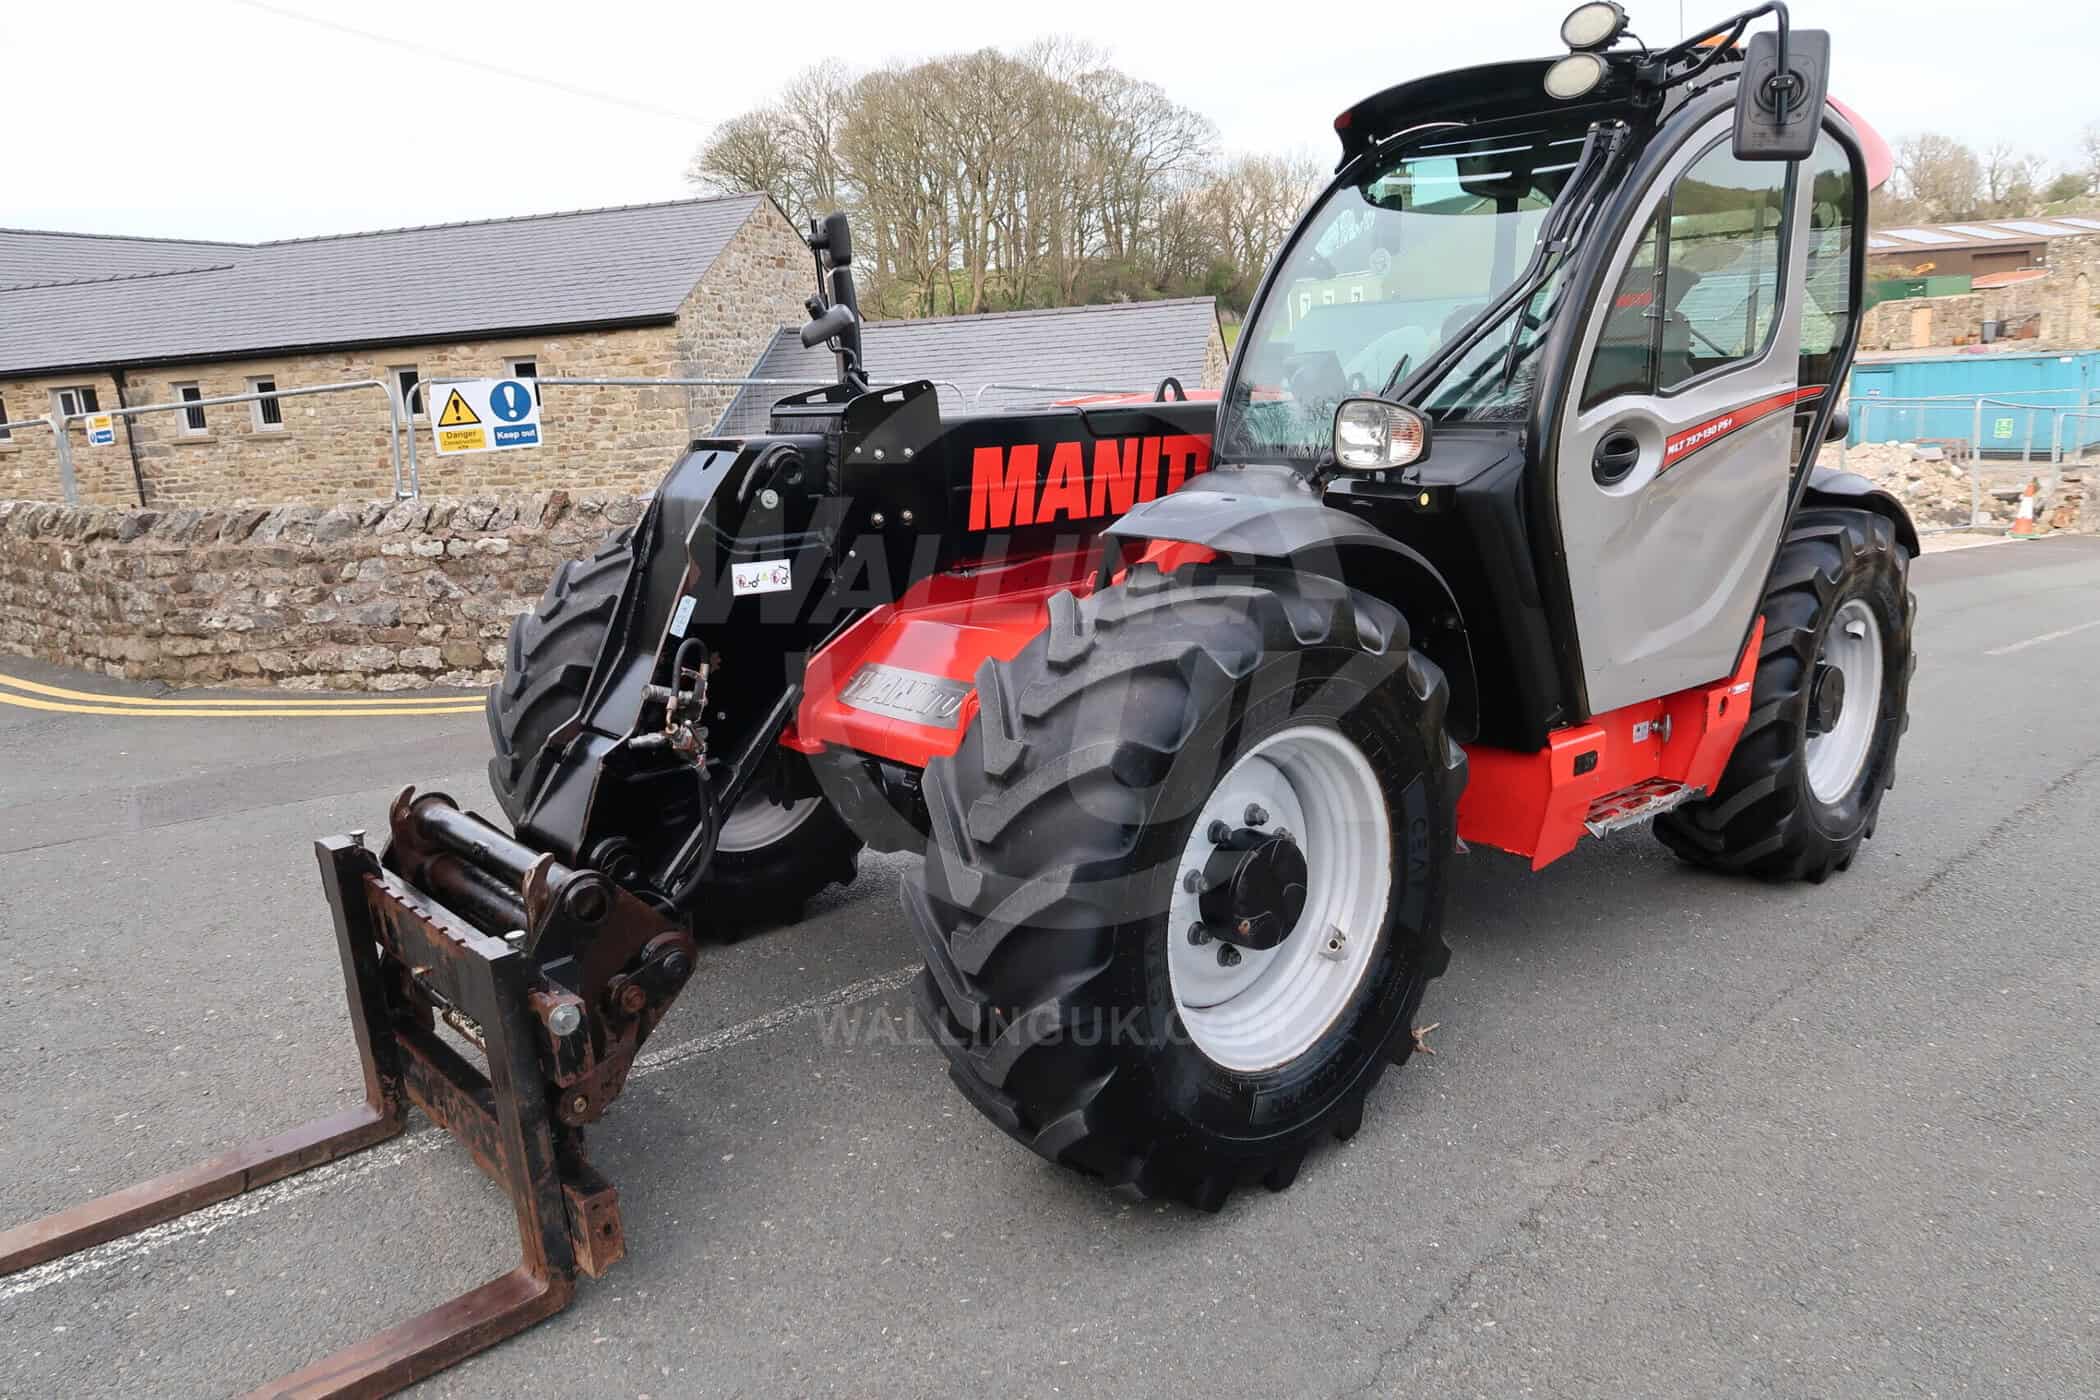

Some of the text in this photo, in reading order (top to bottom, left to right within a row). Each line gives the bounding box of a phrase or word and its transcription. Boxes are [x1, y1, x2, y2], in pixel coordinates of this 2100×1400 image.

[446, 431, 476, 440] Danger
[496, 430, 535, 441] Keep out
[968, 433, 1213, 531] MANIT
